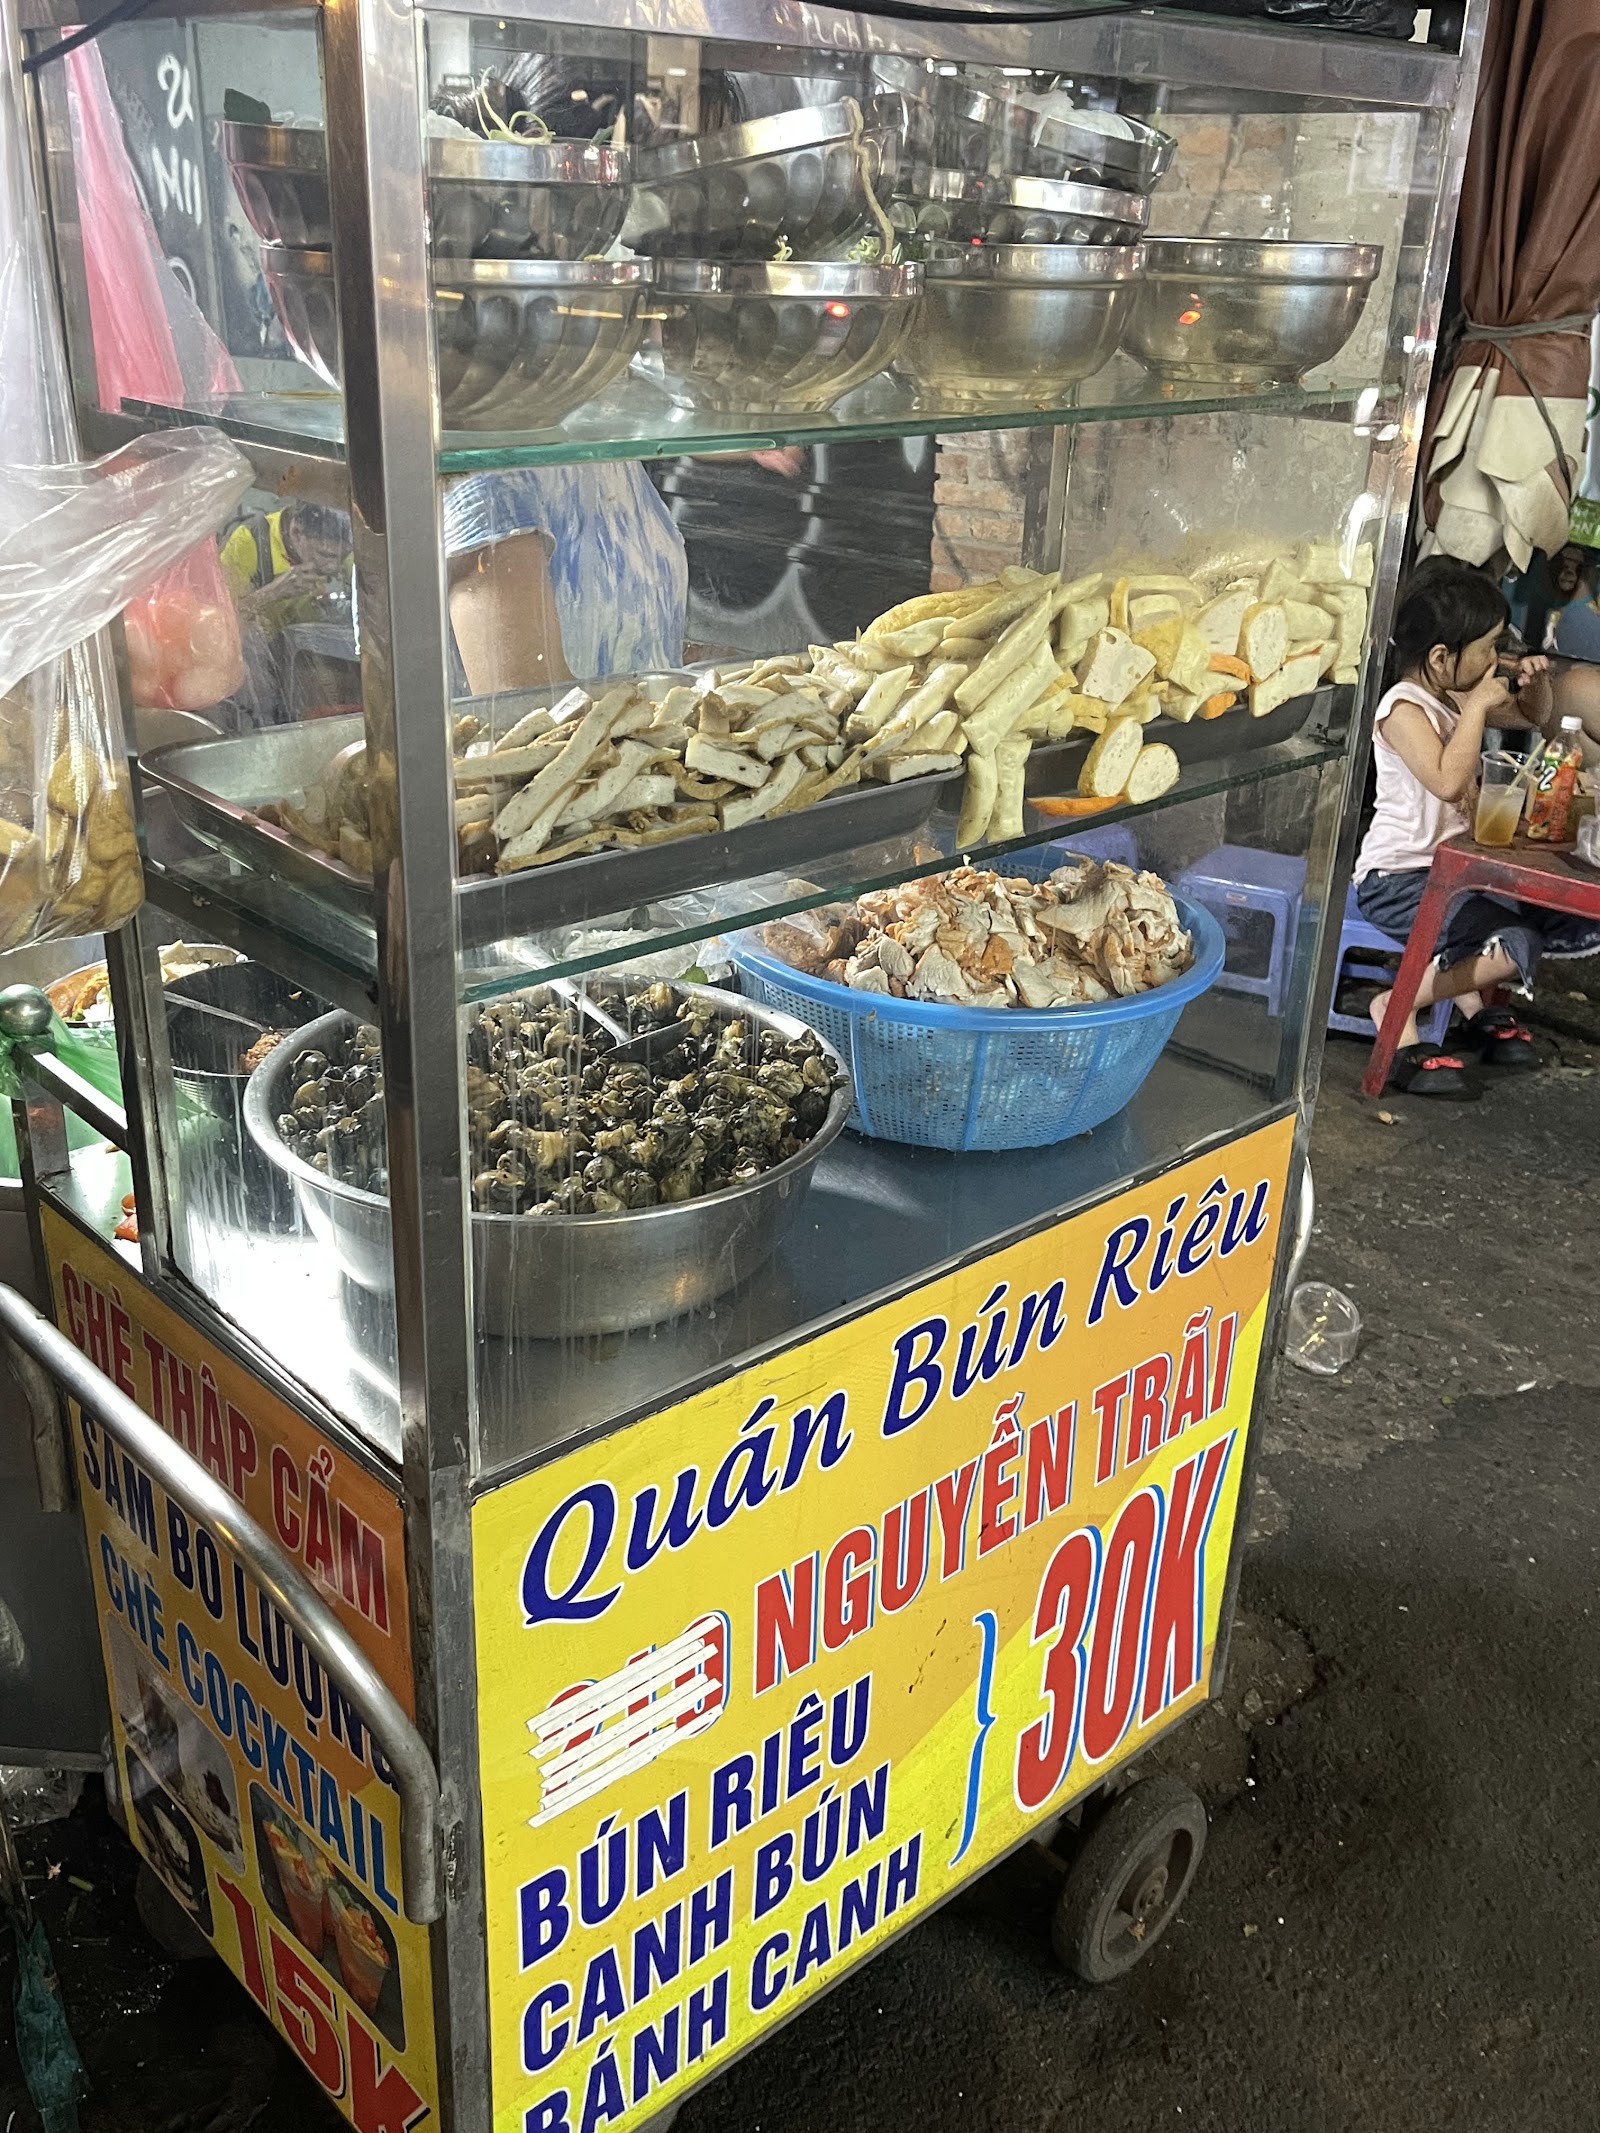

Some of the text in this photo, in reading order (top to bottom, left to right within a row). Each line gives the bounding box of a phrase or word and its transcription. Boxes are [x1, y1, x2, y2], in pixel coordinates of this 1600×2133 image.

[269, 1443, 391, 1637] CẢM
[521, 1175, 1270, 1627] Quán Bún Riêu
[752, 1305, 1240, 1699] NGUYỄN TRÃI
[100, 1532, 399, 1917] CHÈ COCKTAIL
[1013, 1429, 1239, 1814] 30K
[517, 1789, 689, 1972] BÚN
[708, 1672, 874, 1854] RIÊU
[519, 1759, 892, 2075] CANH BÚN
[214, 1871, 432, 2133] 15K
[521, 1832, 925, 2133] BÁNH CANH
